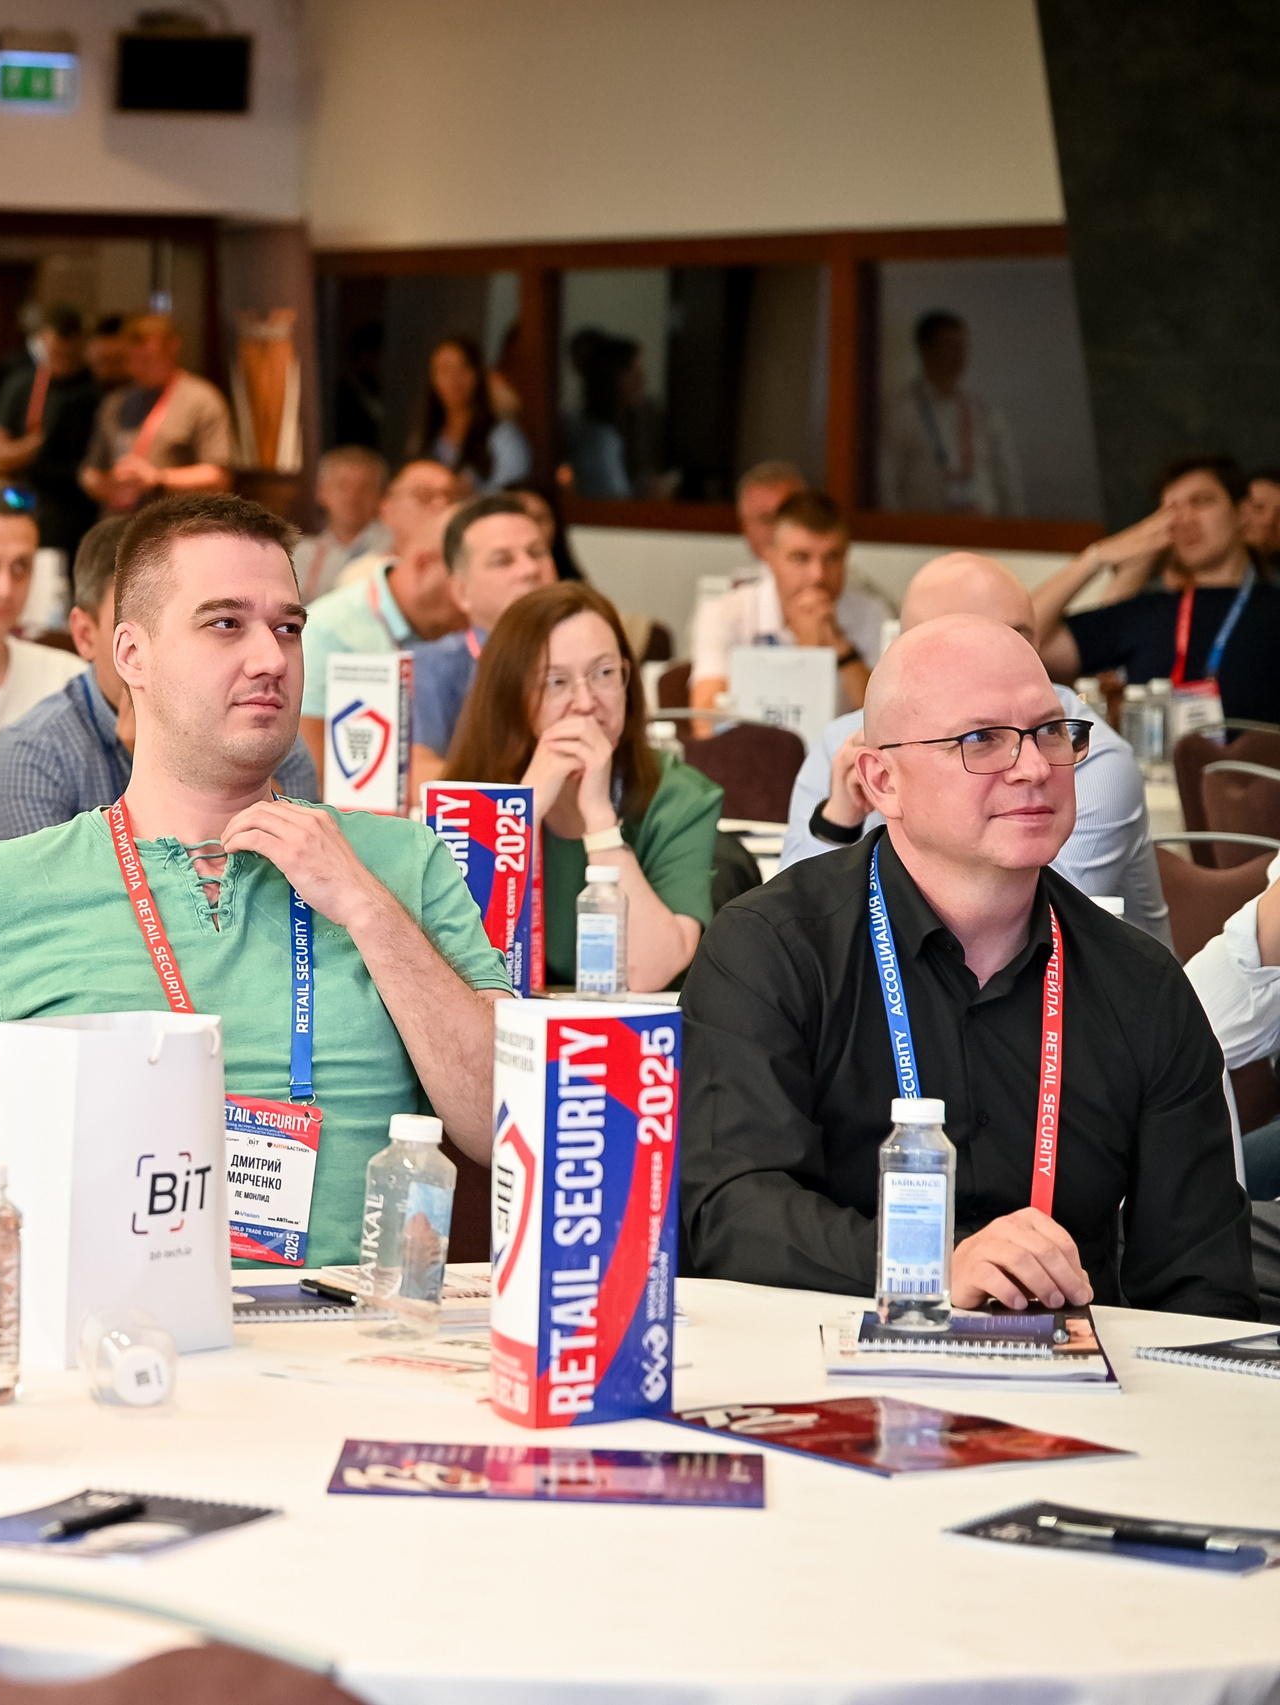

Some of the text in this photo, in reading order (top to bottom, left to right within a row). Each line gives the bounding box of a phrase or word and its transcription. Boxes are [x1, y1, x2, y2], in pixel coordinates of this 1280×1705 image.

[110, 798, 142, 891] ОСТИ РИТЕЙЛА
[435, 792, 470, 878] RITY
[495, 796, 526, 872] 2025
[506, 877, 516, 918] CENTER
[136, 898, 188, 1010] RETAIL SECURITY
[294, 917, 309, 981] SECURITY
[506, 918, 515, 950] TRADE
[868, 895, 904, 1017] АССОЦИАЦИЯ
[295, 983, 309, 1034] RETAIL
[637, 1025, 676, 1145] 2025
[893, 1029, 918, 1100] ECURITY
[254, 1110, 310, 1133] SECURITY
[1038, 1030, 1058, 1177] RETAIL SECURITY
[148, 1164, 212, 1215] BiT
[226, 1170, 282, 1190] МАРЧЕНКО
[230, 1154, 282, 1173] ДМИТРИЙ
[234, 1190, 270, 1203] ЛЕ МОНЛИД
[245, 1227, 262, 1236] TRADE
[283, 1233, 300, 1261] 2025
[359, 1191, 385, 1296] BAIKAL
[547, 1025, 609, 1416] RETAIL SECURITY
[646, 1151, 663, 1322] WORLD TRADE CENTER
